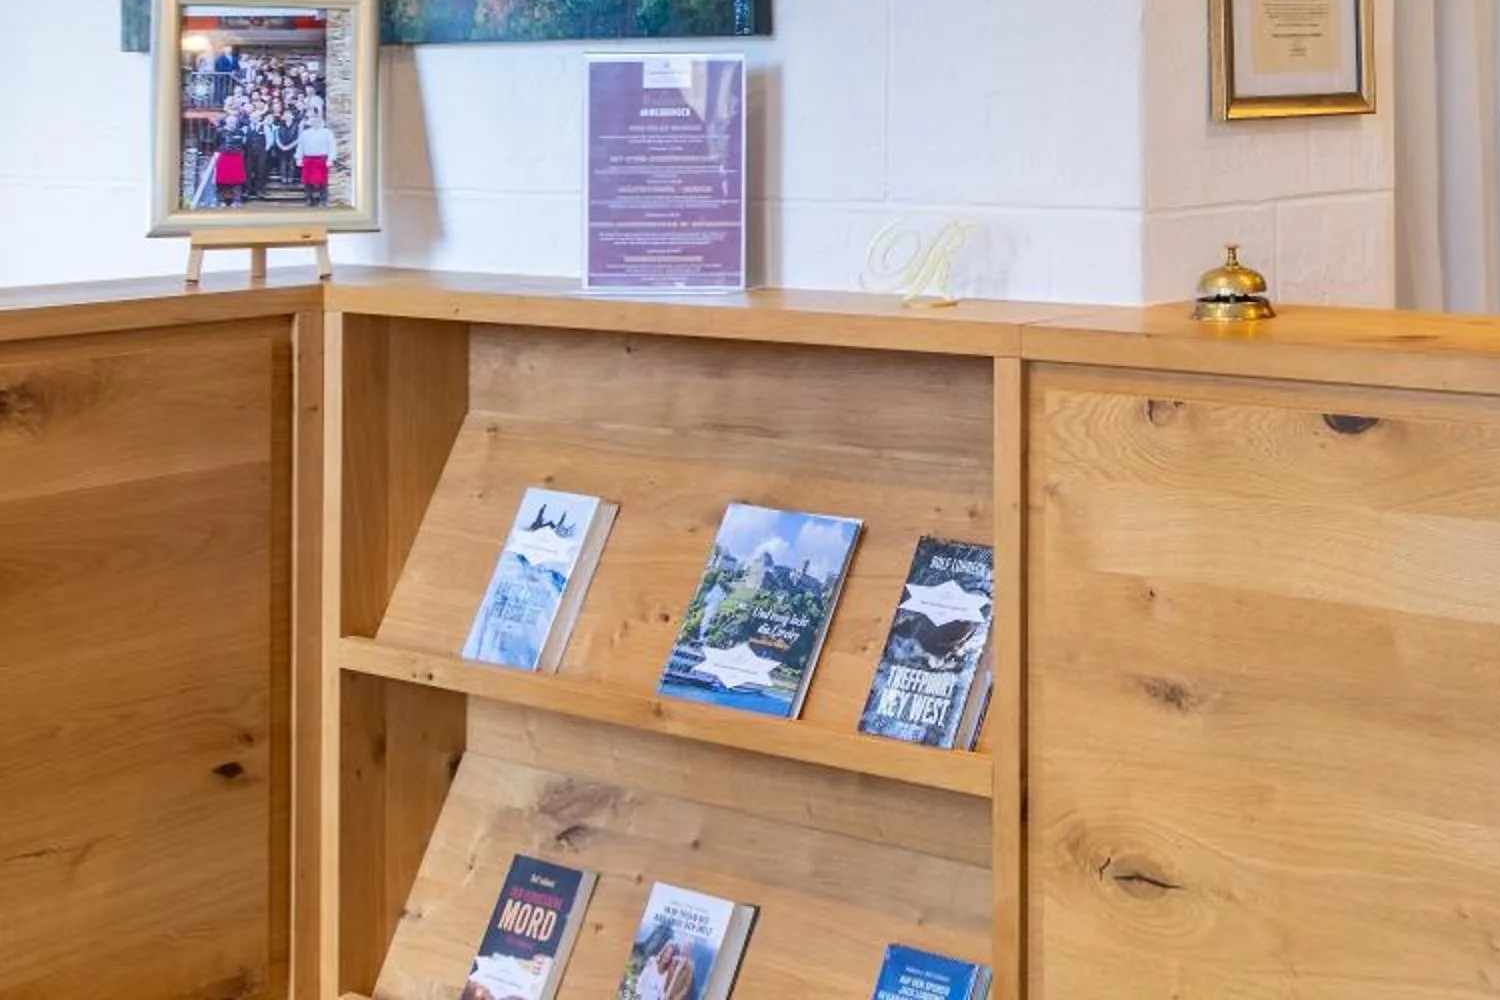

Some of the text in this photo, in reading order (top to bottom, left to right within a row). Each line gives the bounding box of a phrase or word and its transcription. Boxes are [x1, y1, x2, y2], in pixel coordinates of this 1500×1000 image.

[877, 687, 951, 727] KEY WEST
[498, 898, 557, 941] MORD
